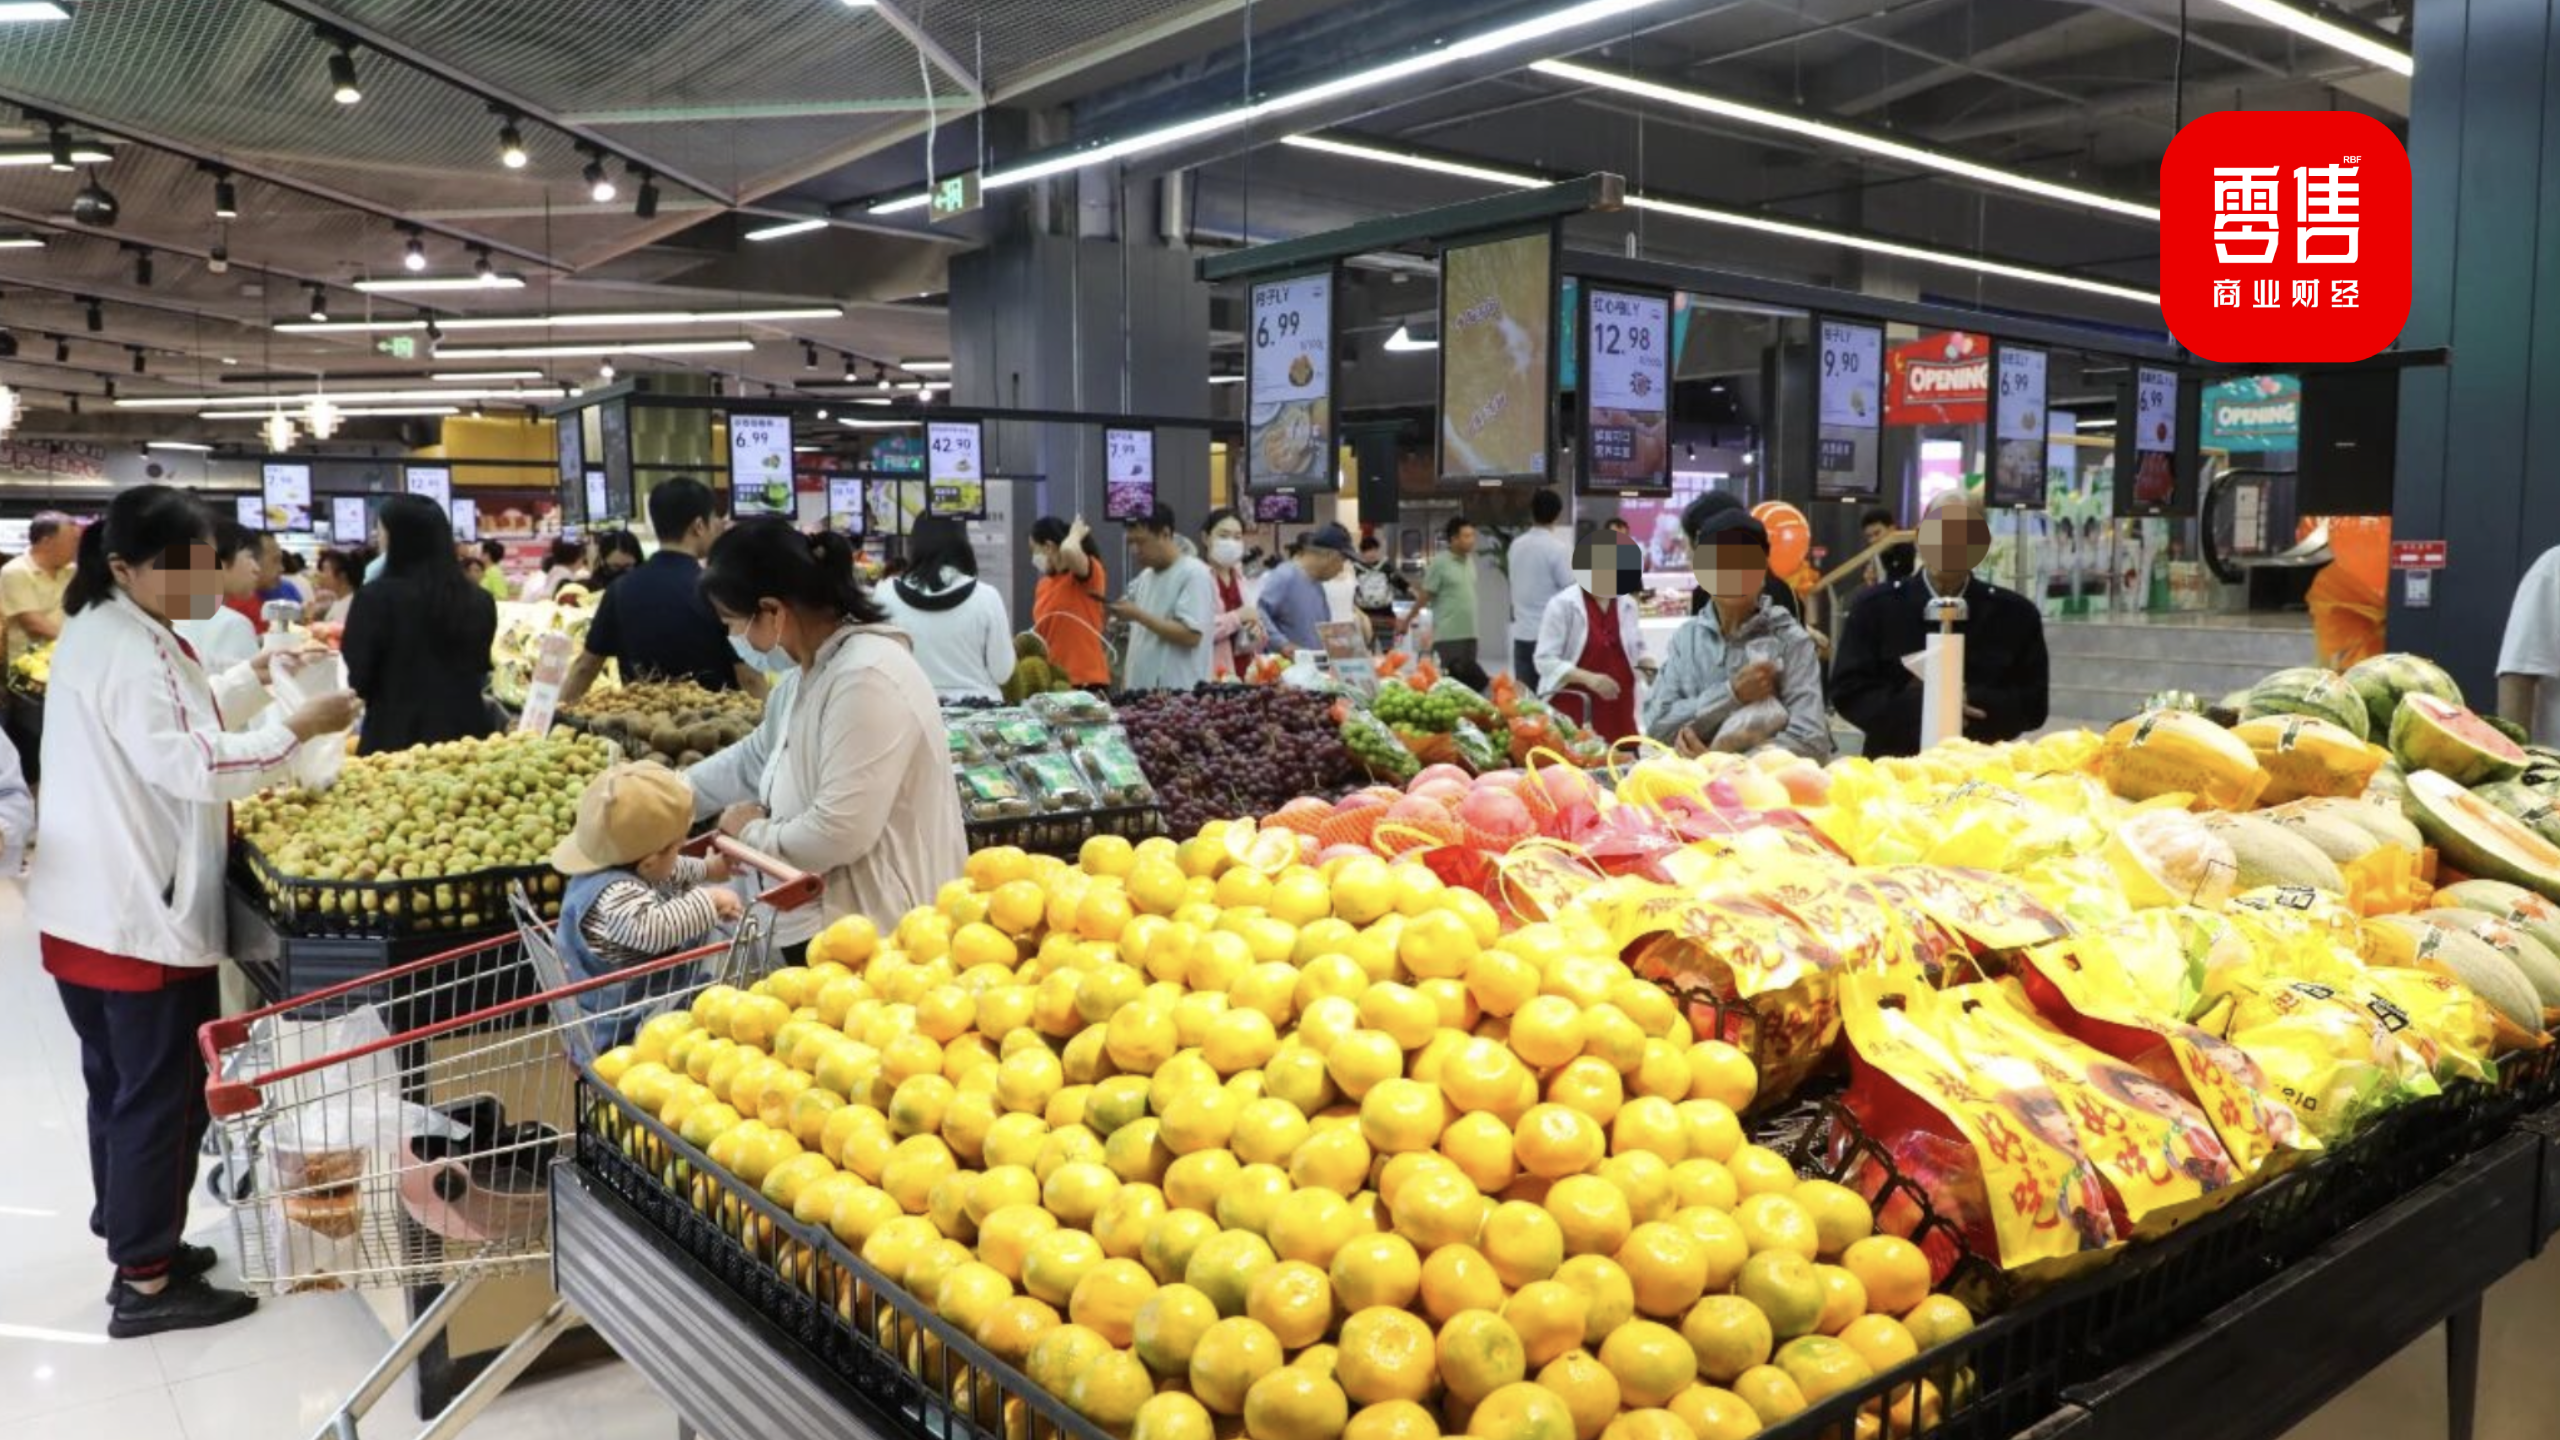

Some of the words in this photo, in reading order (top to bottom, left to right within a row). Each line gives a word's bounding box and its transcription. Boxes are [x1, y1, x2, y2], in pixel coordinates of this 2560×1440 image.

[1256, 311, 1300, 348] 6.99
[1595, 323, 1651, 354] 12.98
[1824, 350, 1858, 377] 9.90
[1910, 363, 1988, 391] OPENING
[2001, 372, 2028, 397] 6.99
[2140, 390, 2163, 412] 6.99
[2219, 402, 2296, 426] OPENING
[736, 432, 768, 447] 6.99
